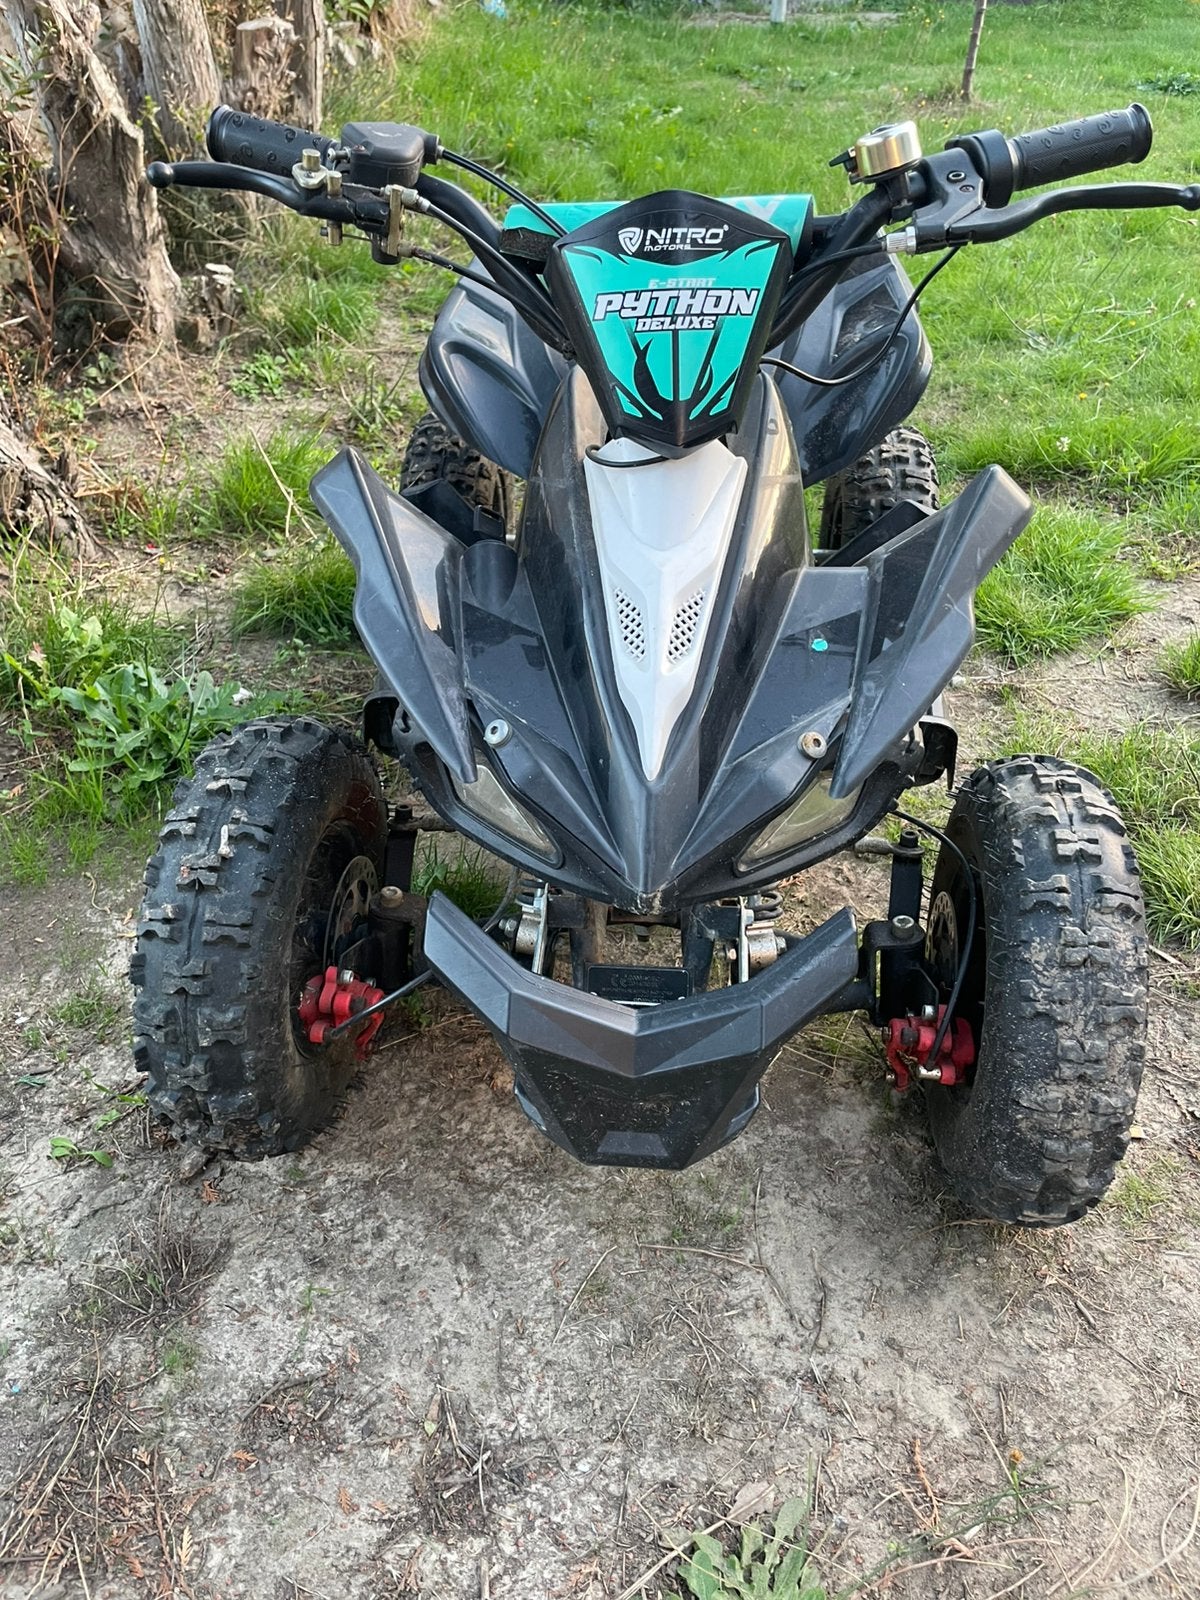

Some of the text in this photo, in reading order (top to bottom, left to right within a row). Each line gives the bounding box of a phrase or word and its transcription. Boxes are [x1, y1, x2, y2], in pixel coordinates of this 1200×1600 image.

[645, 228, 724, 245] NITRO
[644, 244, 691, 252] MOTORS
[648, 277, 716, 289] E-START
[593, 289, 759, 321] PYTHON
[636, 316, 716, 331] DELUXE
